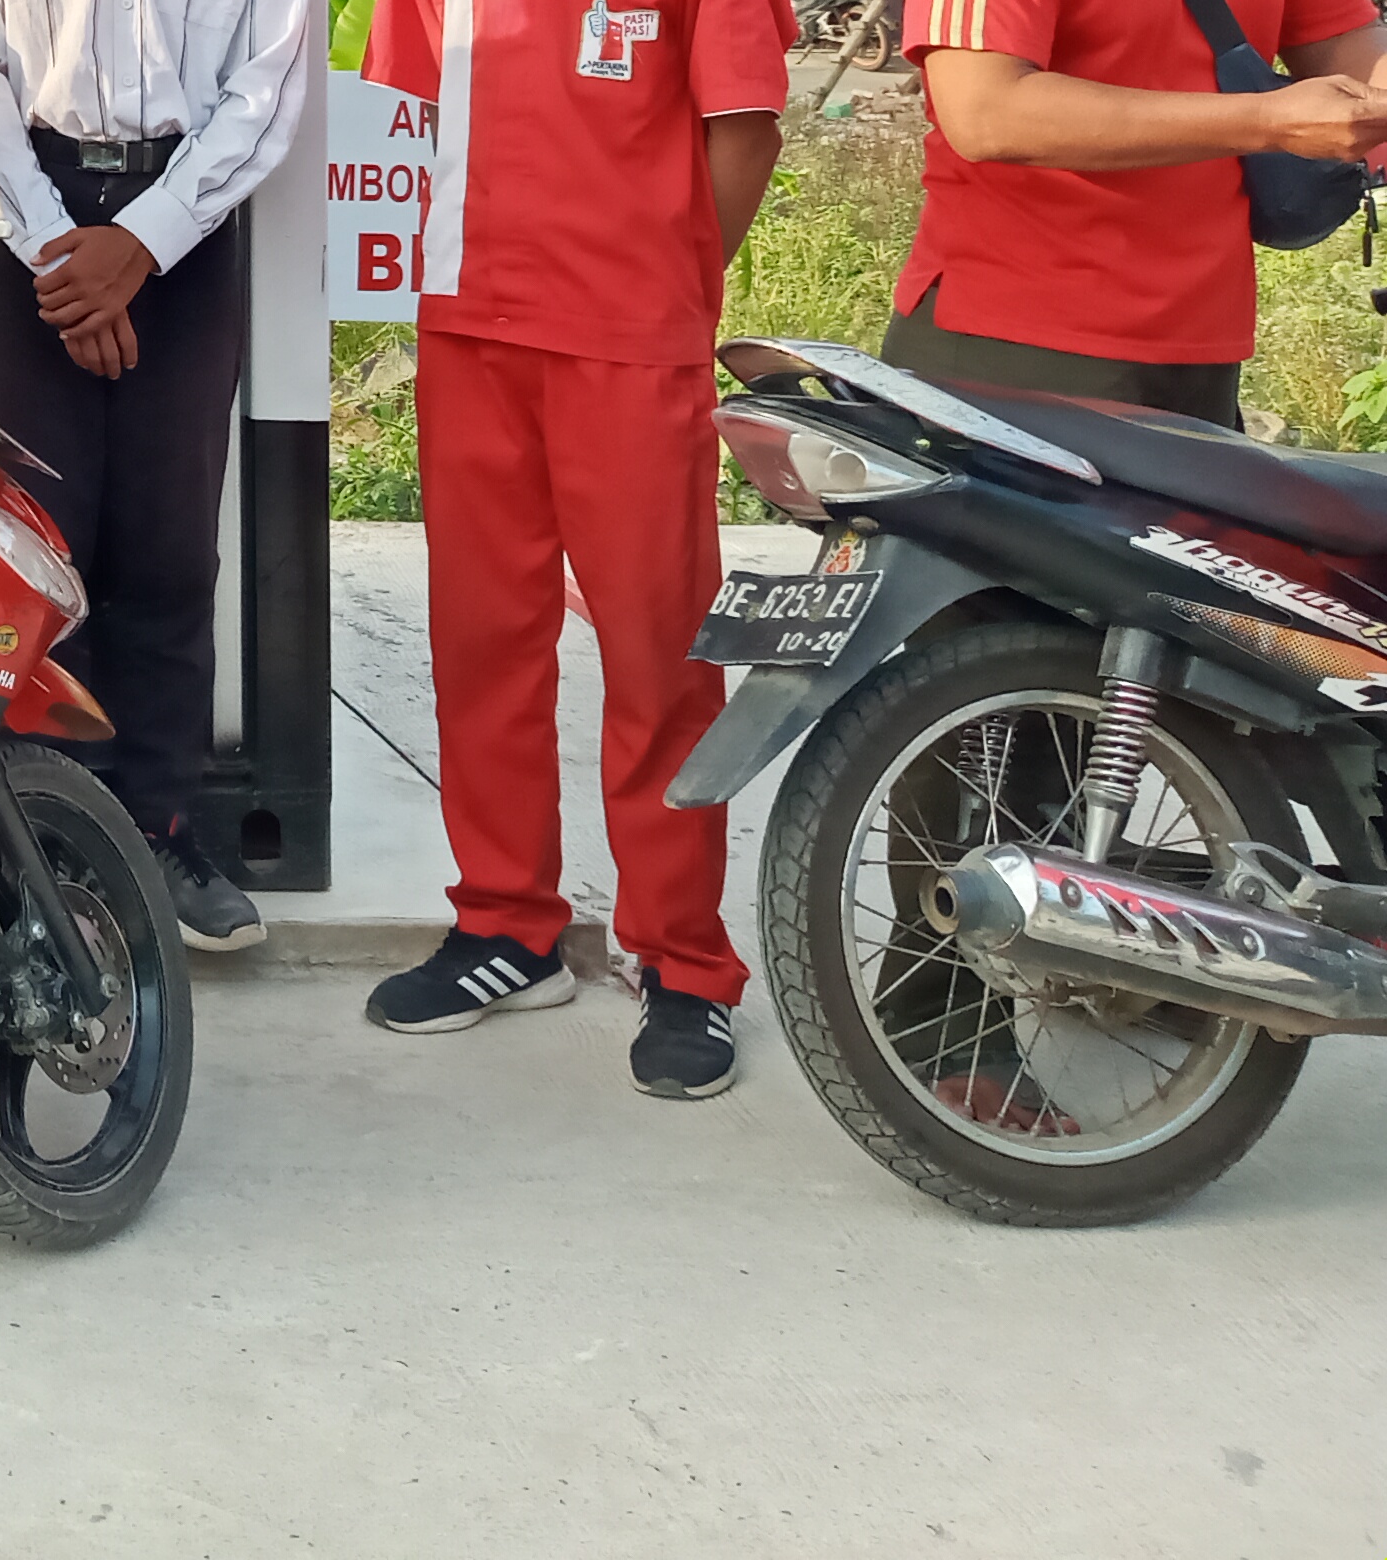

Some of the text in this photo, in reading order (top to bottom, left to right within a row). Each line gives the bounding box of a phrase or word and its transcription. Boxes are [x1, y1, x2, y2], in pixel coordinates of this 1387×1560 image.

[624, 13, 654, 25] PASTI
[357, 233, 423, 293] B
[709, 580, 758, 619] BE
